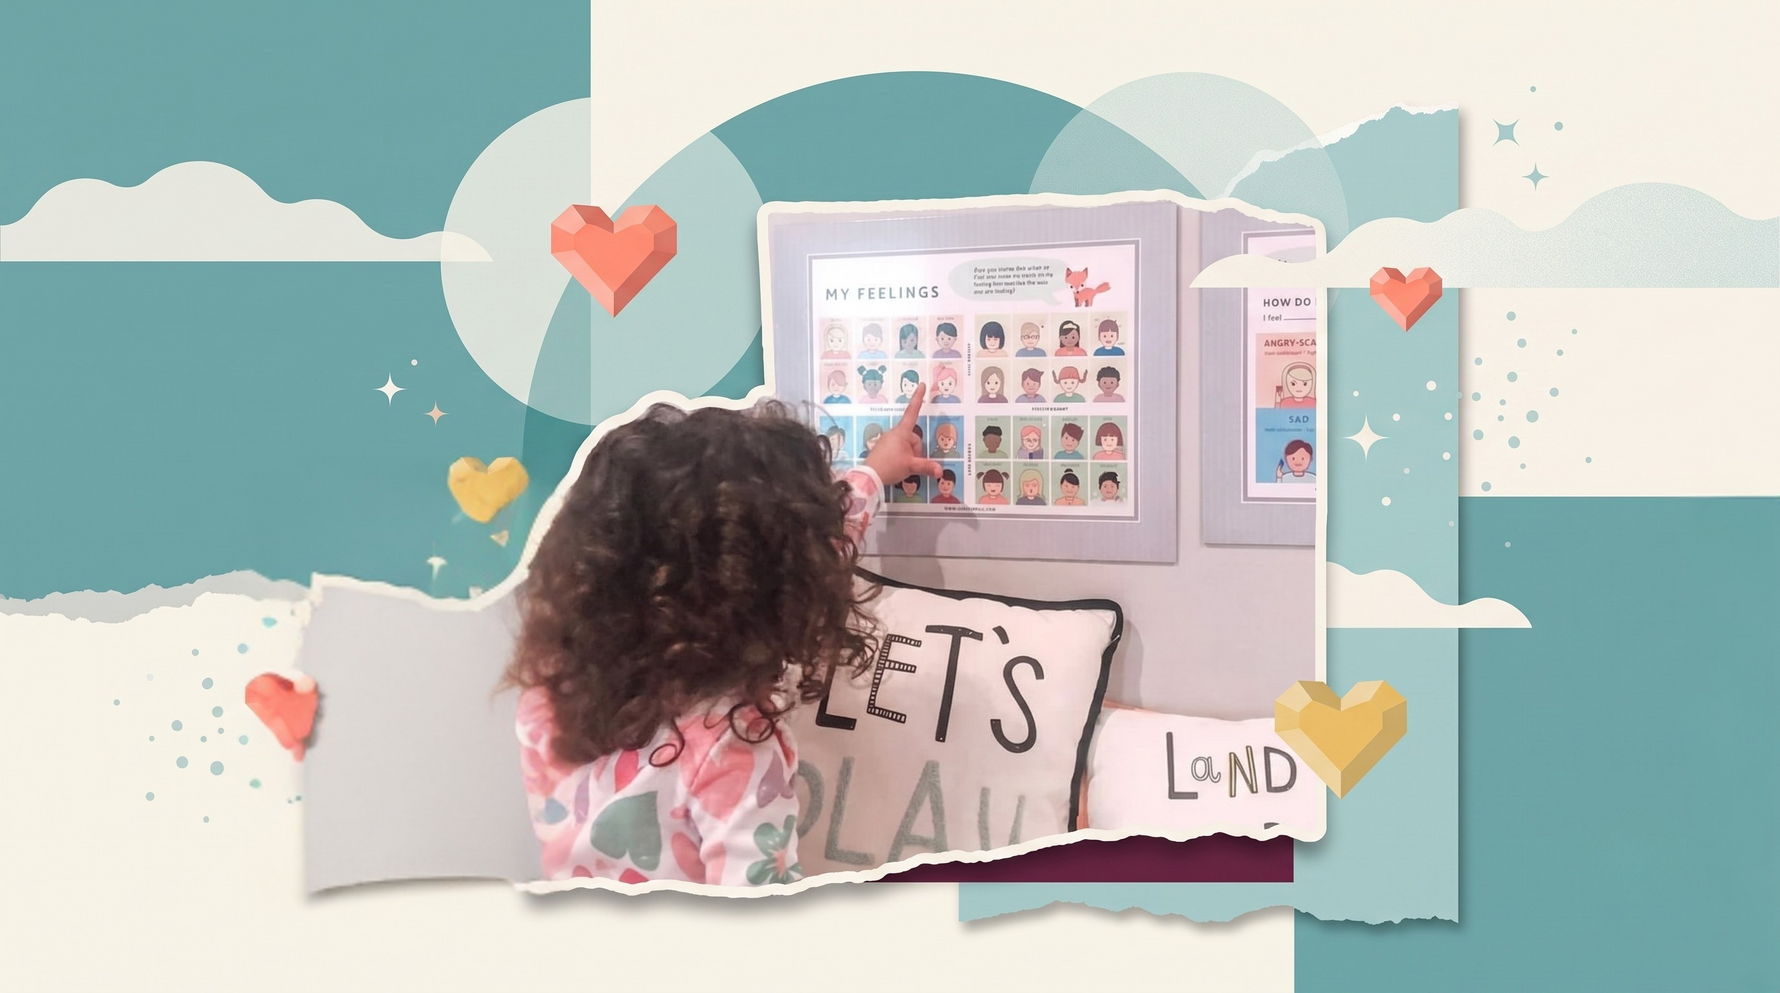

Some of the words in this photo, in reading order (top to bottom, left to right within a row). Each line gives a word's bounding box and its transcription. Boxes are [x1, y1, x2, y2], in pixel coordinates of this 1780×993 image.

[826, 288, 850, 301] MY
[858, 286, 939, 300] FEELINGS
[1263, 298, 1291, 307] HOW
[1295, 297, 1311, 307] DO
[1264, 338, 1317, 347] ANGRY-SCA
[1288, 415, 1309, 424] SAD
[815, 625, 1045, 754] LET'S
